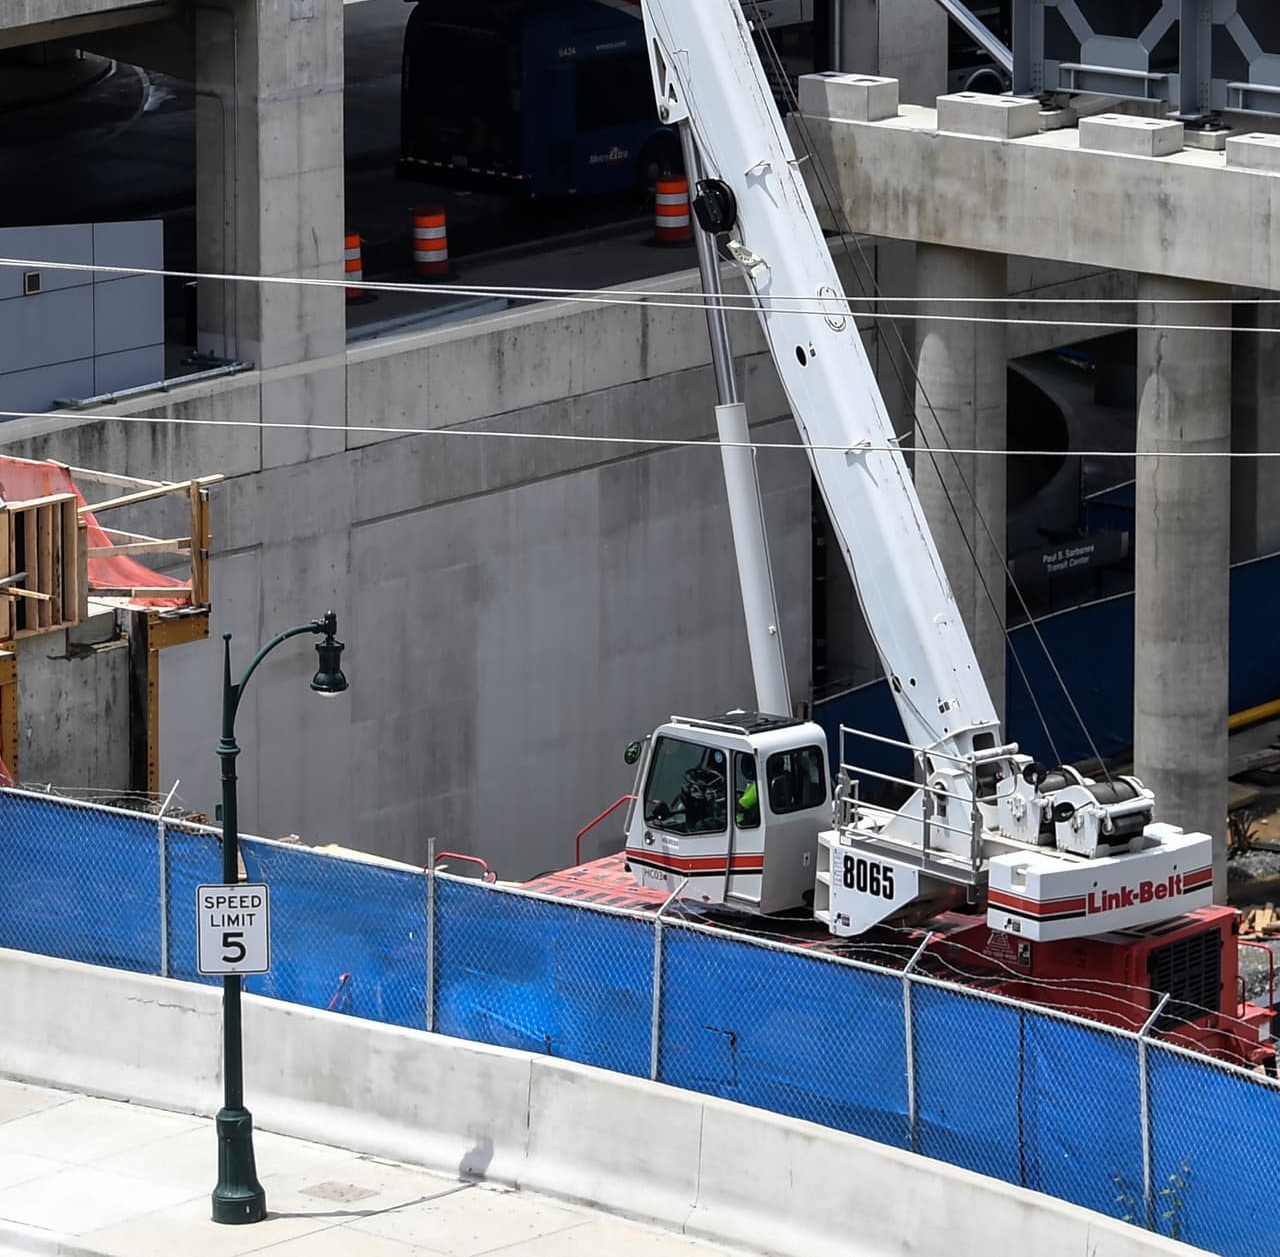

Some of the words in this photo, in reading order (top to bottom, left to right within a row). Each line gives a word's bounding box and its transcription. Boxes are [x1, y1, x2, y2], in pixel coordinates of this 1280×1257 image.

[1042, 553, 1057, 563] Paul
[1065, 545, 1094, 558] Sarbanes
[1047, 560, 1068, 572] Transit
[1069, 556, 1090, 568] Center
[843, 854, 894, 900] 8065
[204, 895, 262, 909] SPEED
[1087, 874, 1184, 914] Link-Belt
[210, 913, 256, 928] LIMIT
[221, 932, 247, 964] 5
